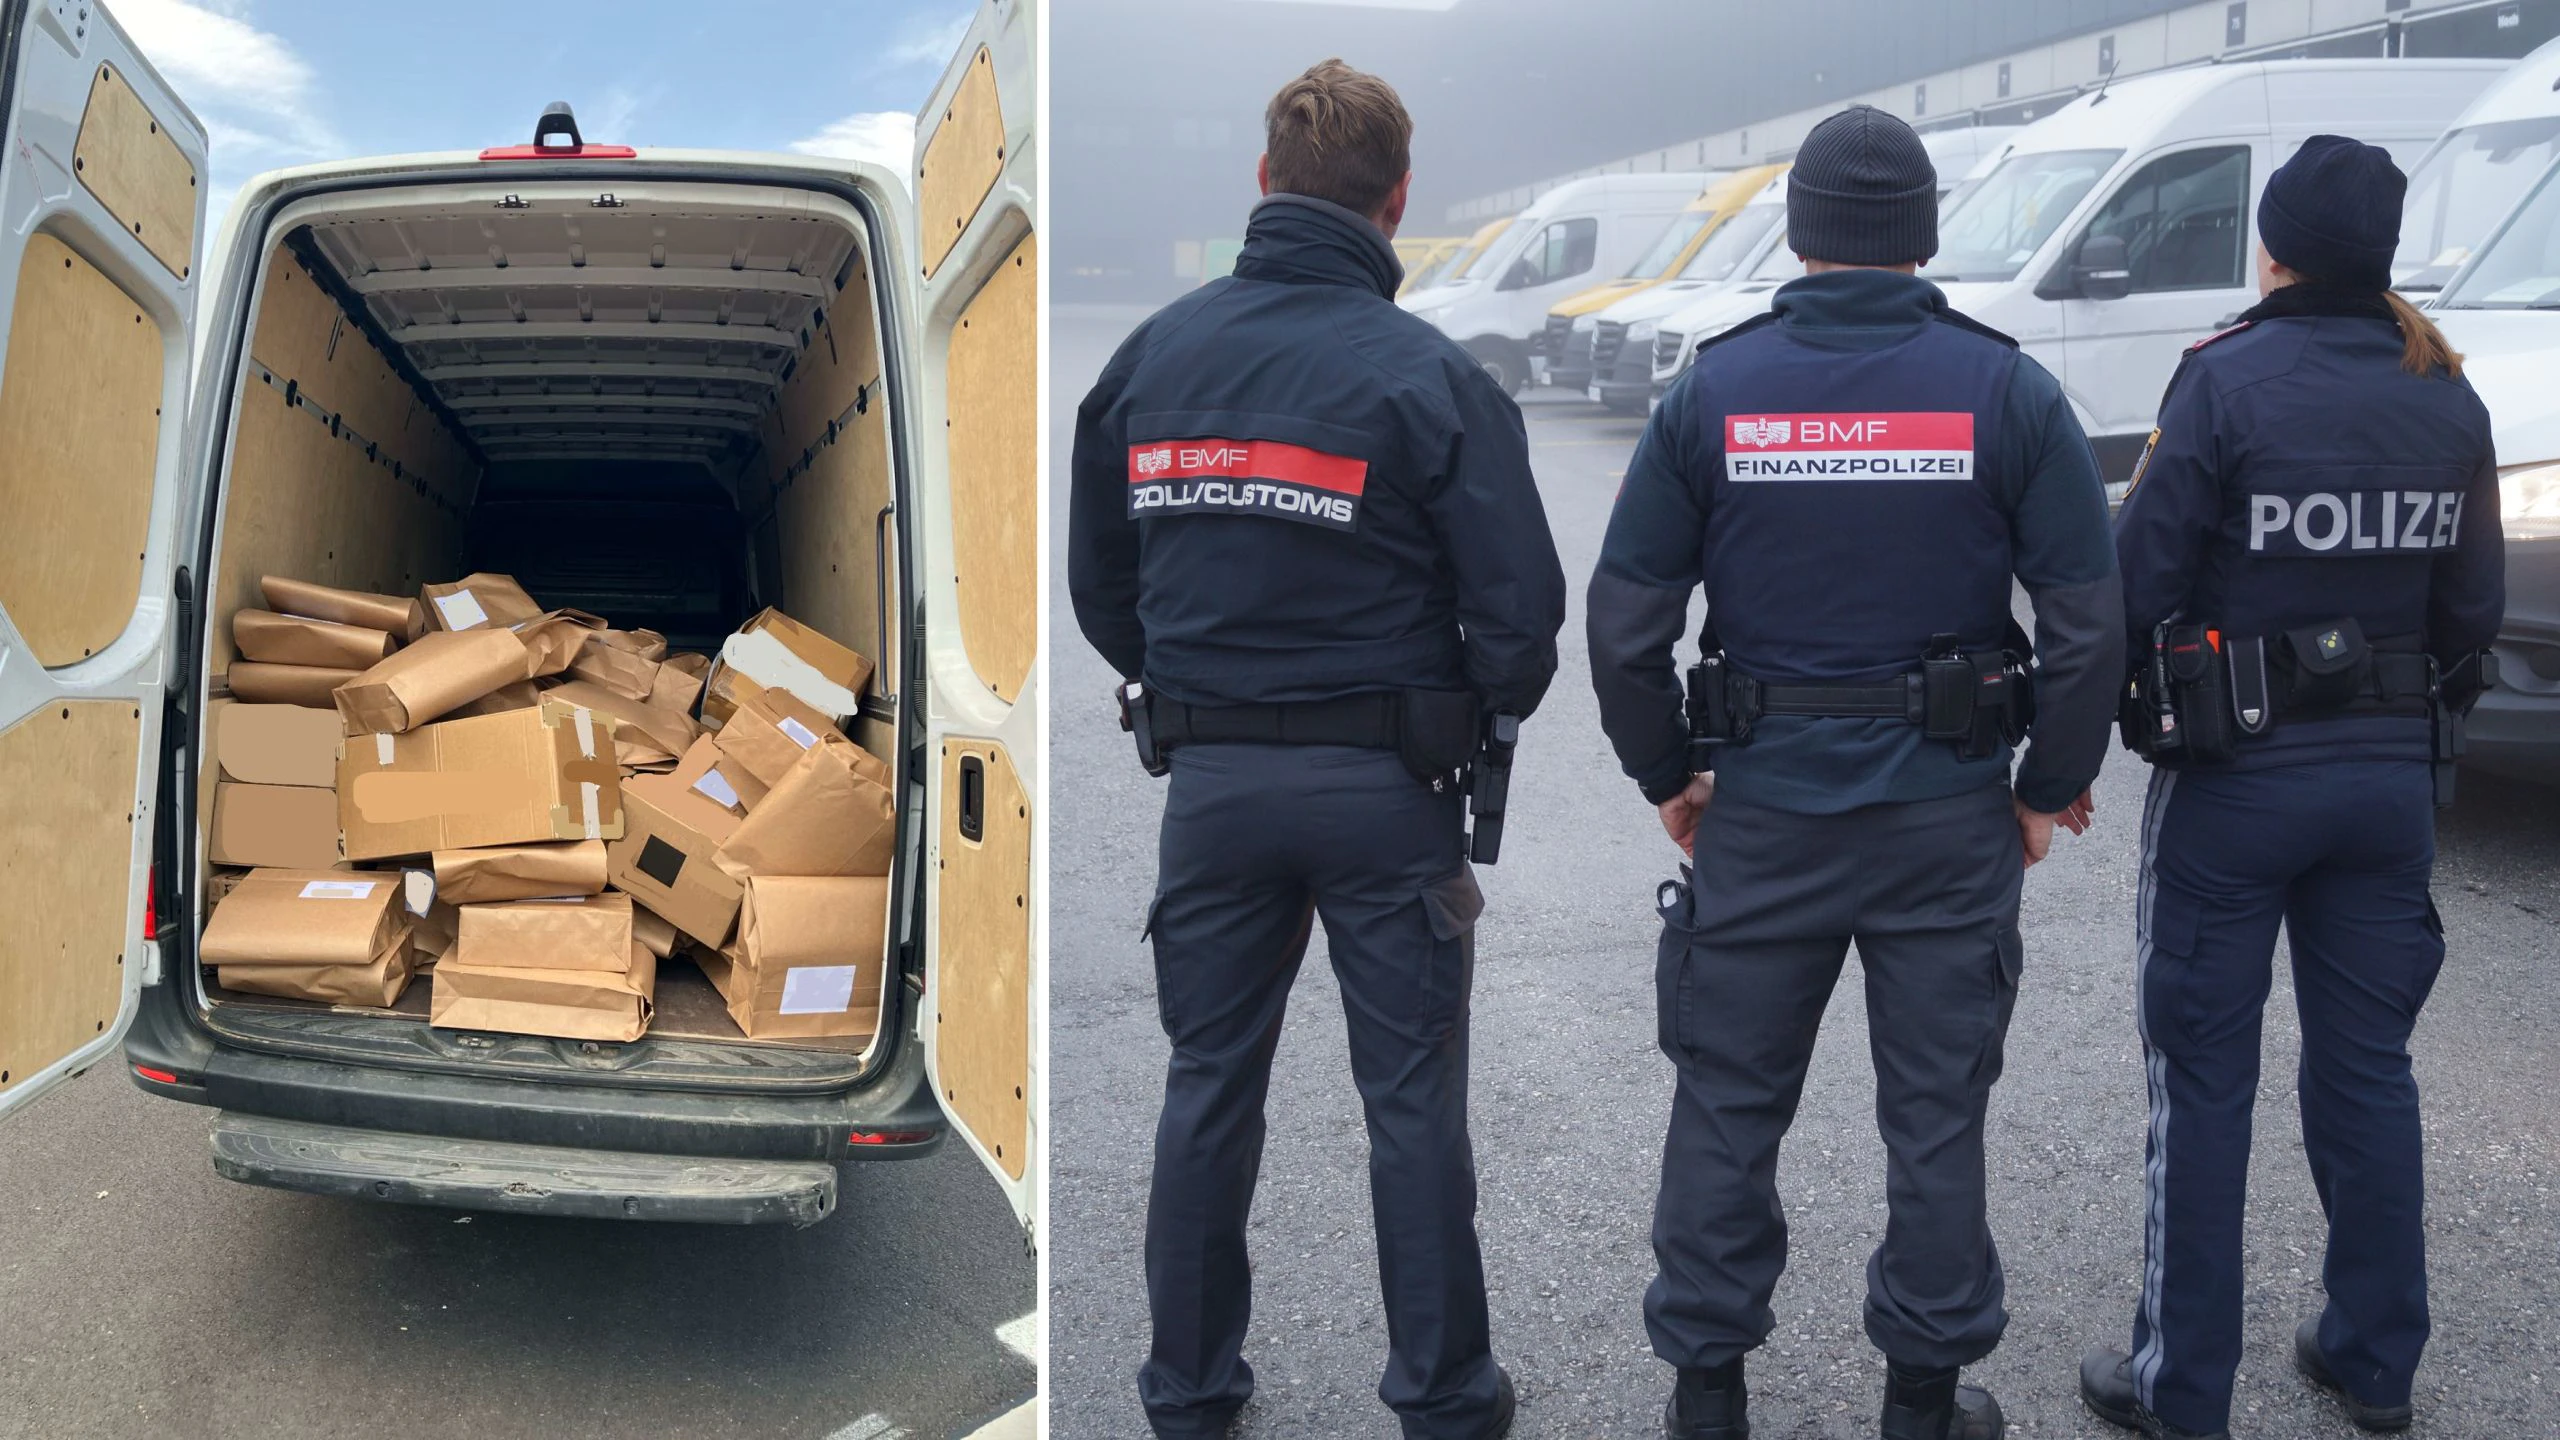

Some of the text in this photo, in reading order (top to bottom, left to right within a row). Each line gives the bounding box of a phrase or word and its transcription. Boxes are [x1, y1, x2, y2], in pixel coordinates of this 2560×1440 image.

[1800, 421, 1888, 443] BMF
[1180, 448, 1248, 469] BMF
[1734, 458, 1964, 475] FINANZPOLIZEI
[1133, 482, 1353, 523] ZOLL/CUSTOMS
